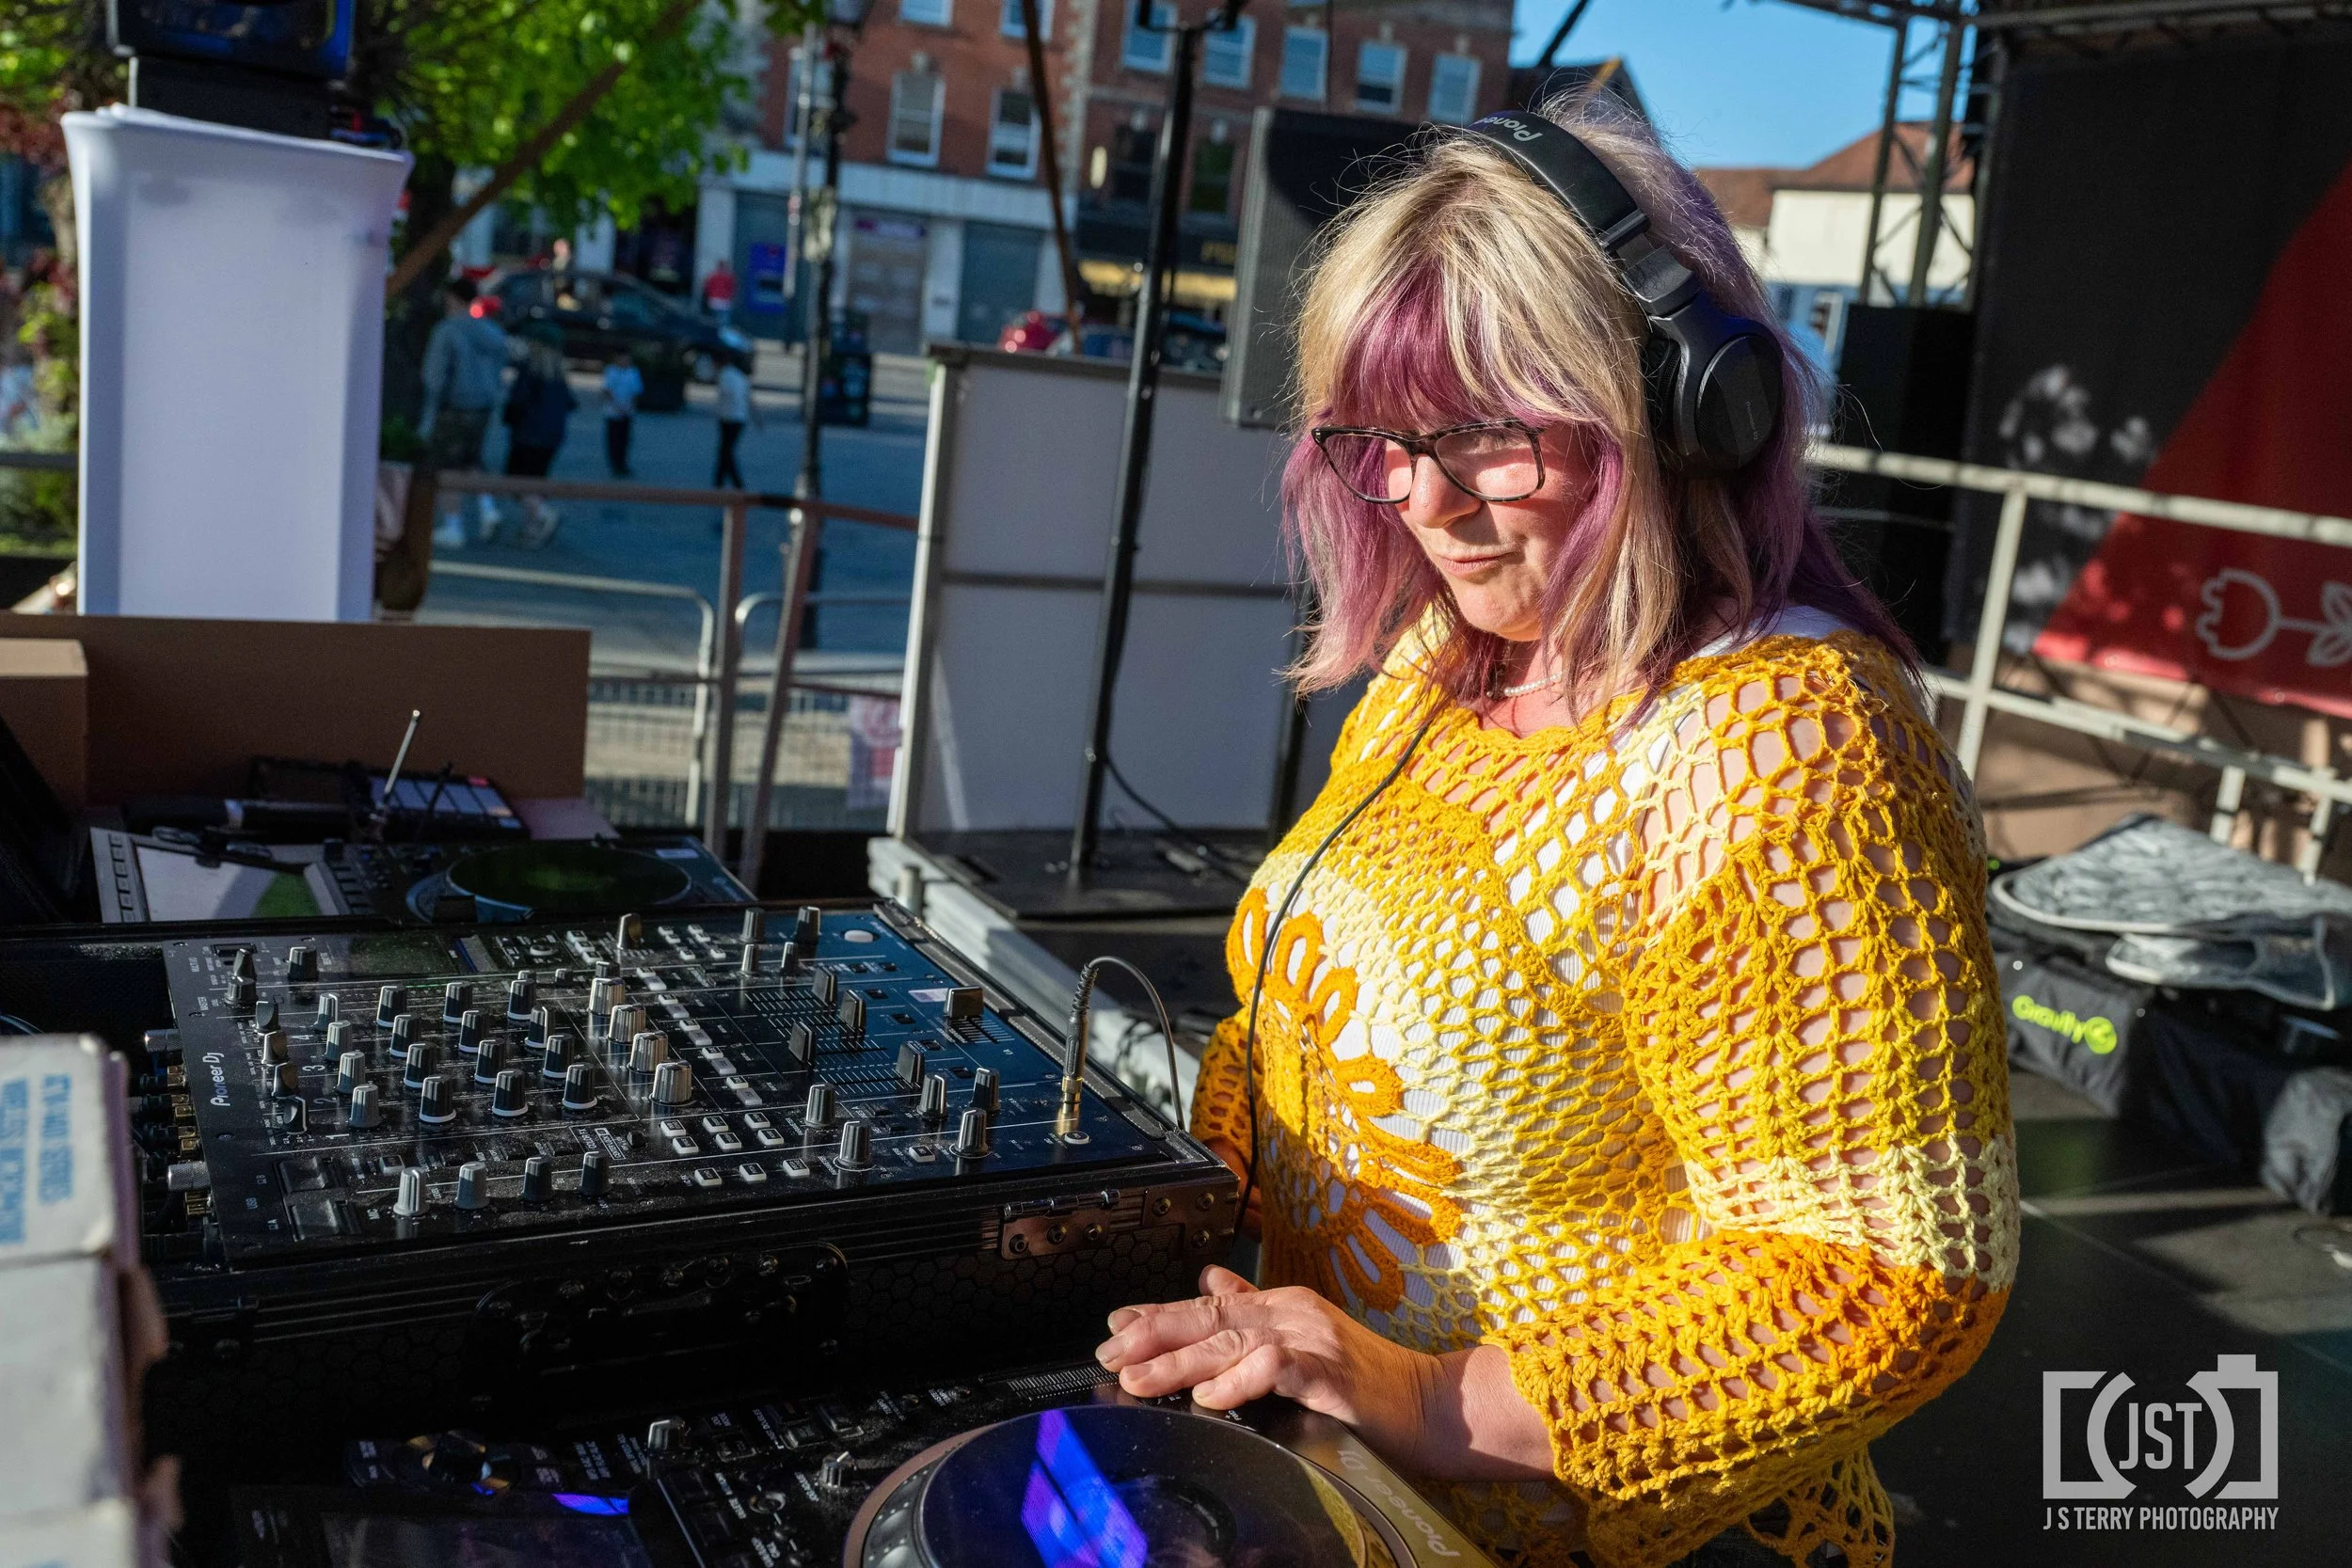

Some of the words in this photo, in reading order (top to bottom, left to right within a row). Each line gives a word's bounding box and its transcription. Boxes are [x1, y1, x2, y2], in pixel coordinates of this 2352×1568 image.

[202, 1052, 225, 1064] DJ
[210, 1065, 231, 1106] Pioneer
[312, 1096, 338, 1104] 2
[580, 1133, 597, 1148] COLOR
[245, 1196, 259, 1210] USB
[365, 1207, 381, 1220] MIC
[874, 1397, 894, 1415] TEMPO
[1337, 1449, 1369, 1470] DJ
[1365, 1475, 1461, 1557] Pioneer
